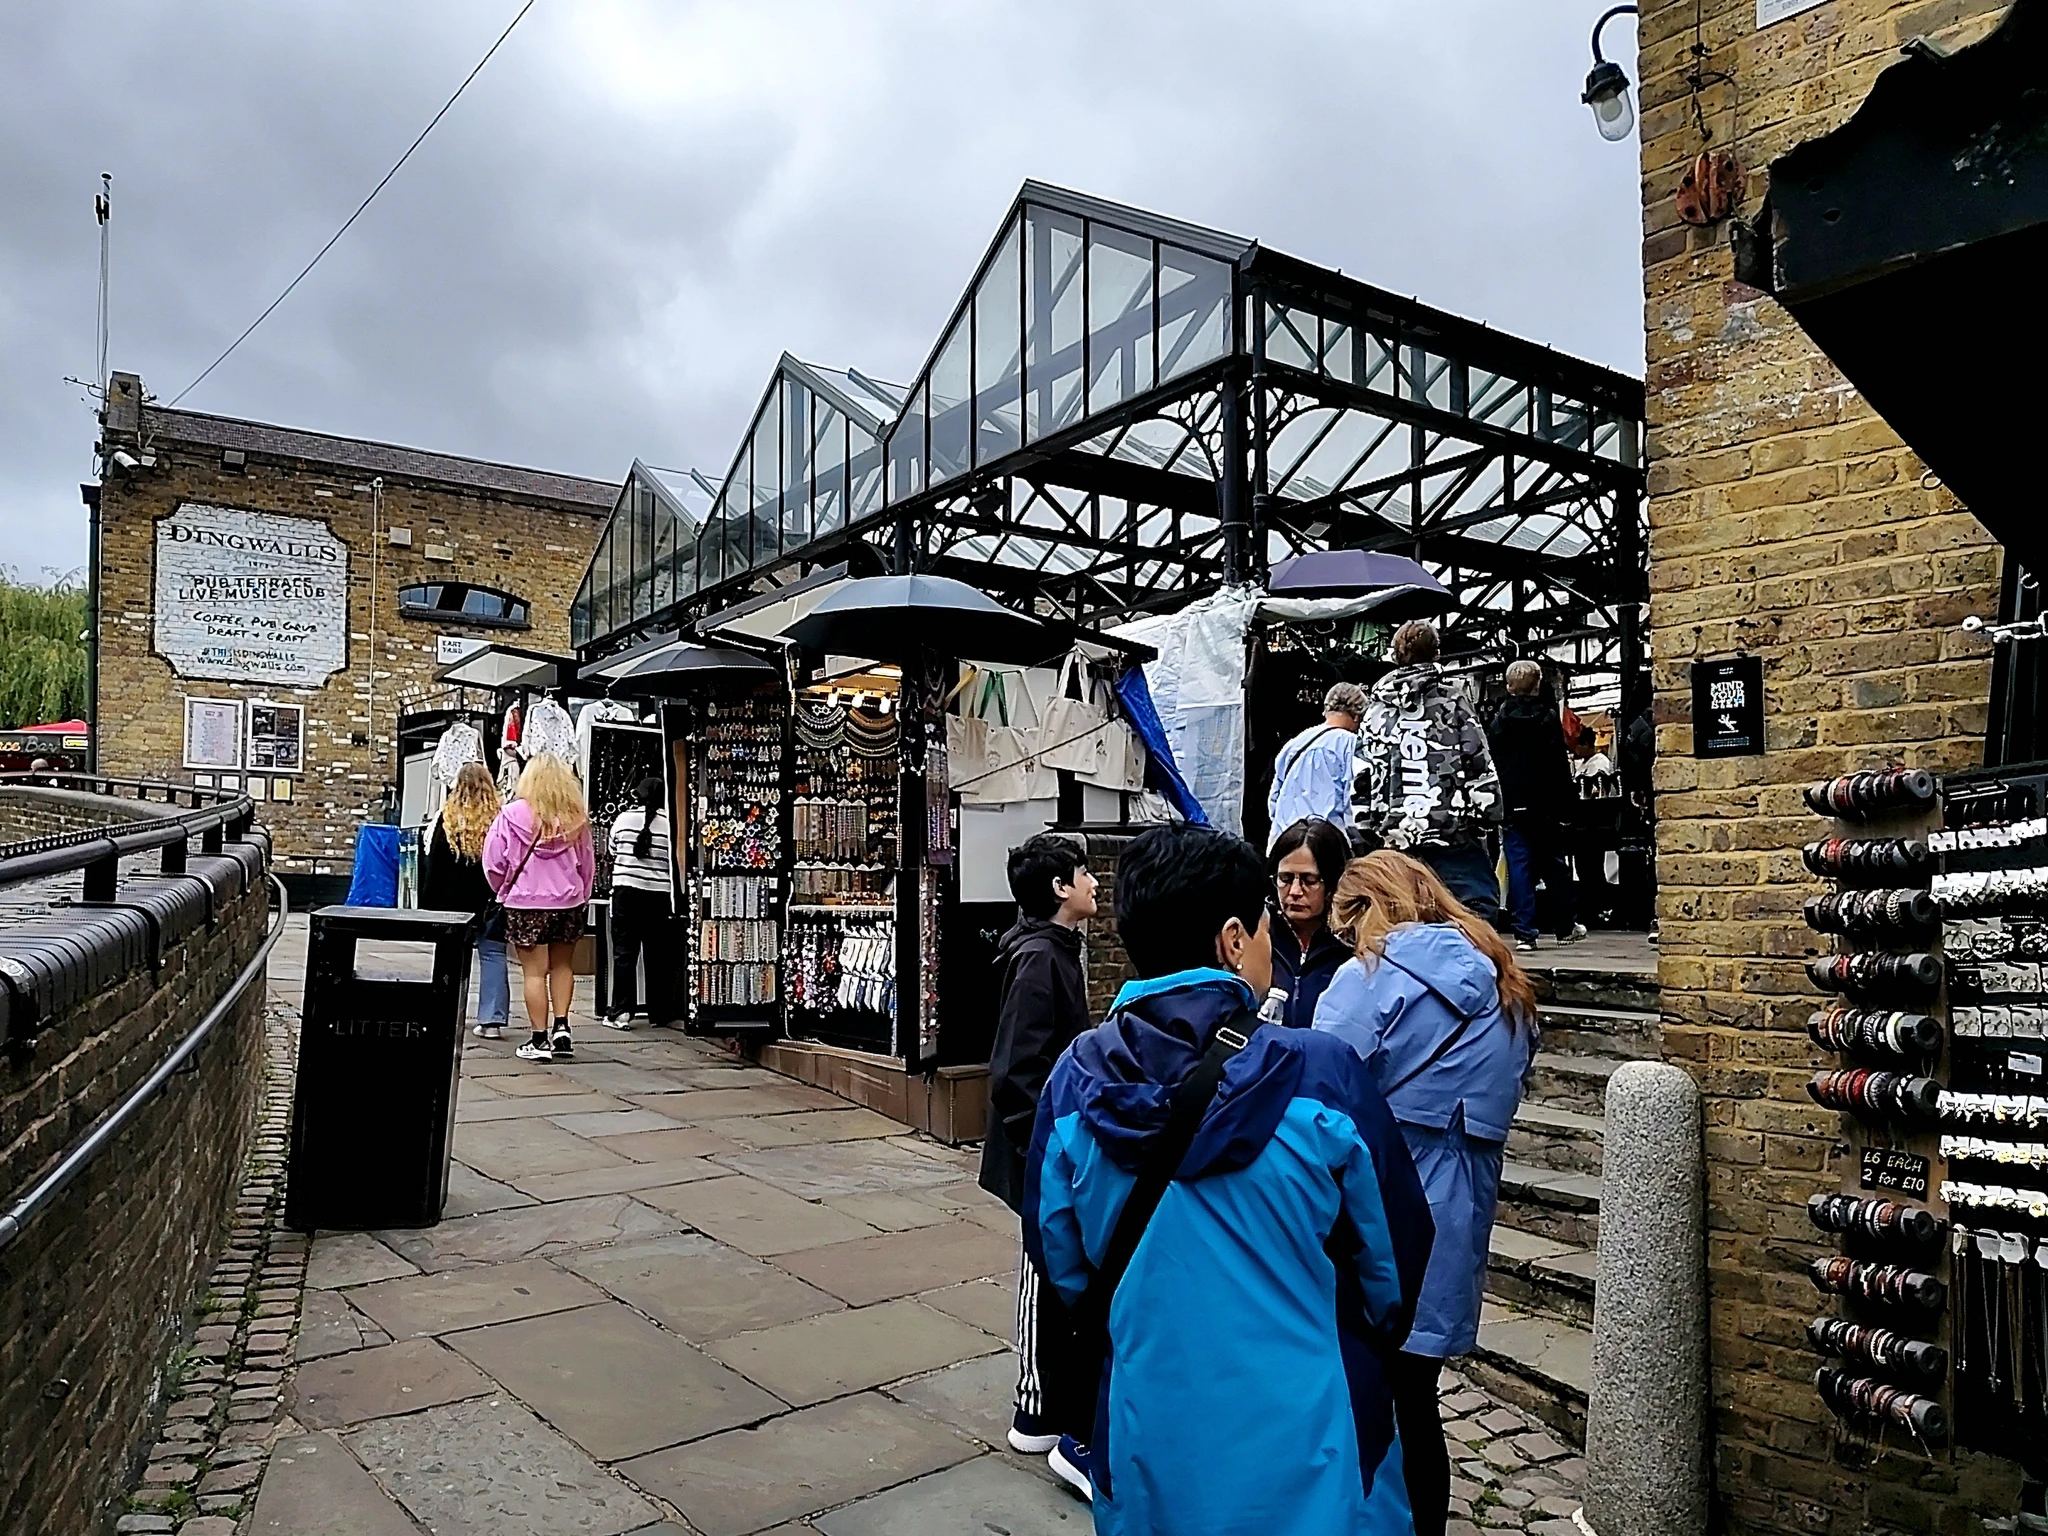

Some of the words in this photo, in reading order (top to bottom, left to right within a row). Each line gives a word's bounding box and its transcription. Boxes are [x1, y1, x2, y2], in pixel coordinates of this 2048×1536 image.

[170, 525, 337, 562] DINGWALLS
[194, 577, 229, 589] PUB
[235, 577, 312, 589] TERRACE
[178, 588, 219, 600] LIVE
[225, 588, 278, 600] MUSIC
[283, 587, 326, 599] CLUB
[207, 625, 250, 638] DRAFT
[267, 632, 309, 644] CRAFT
[1710, 680, 1745, 691] MIND
[1710, 689, 1745, 700] YOUR
[1711, 697, 1745, 709] STEP
[335, 1020, 420, 1038] LITTER
[1863, 1151, 1881, 1164] £6
[1887, 1155, 1923, 1172] EACH
[1862, 1168, 1873, 1181] 2
[1879, 1171, 1897, 1185] for
[1902, 1176, 1925, 1191] £10
